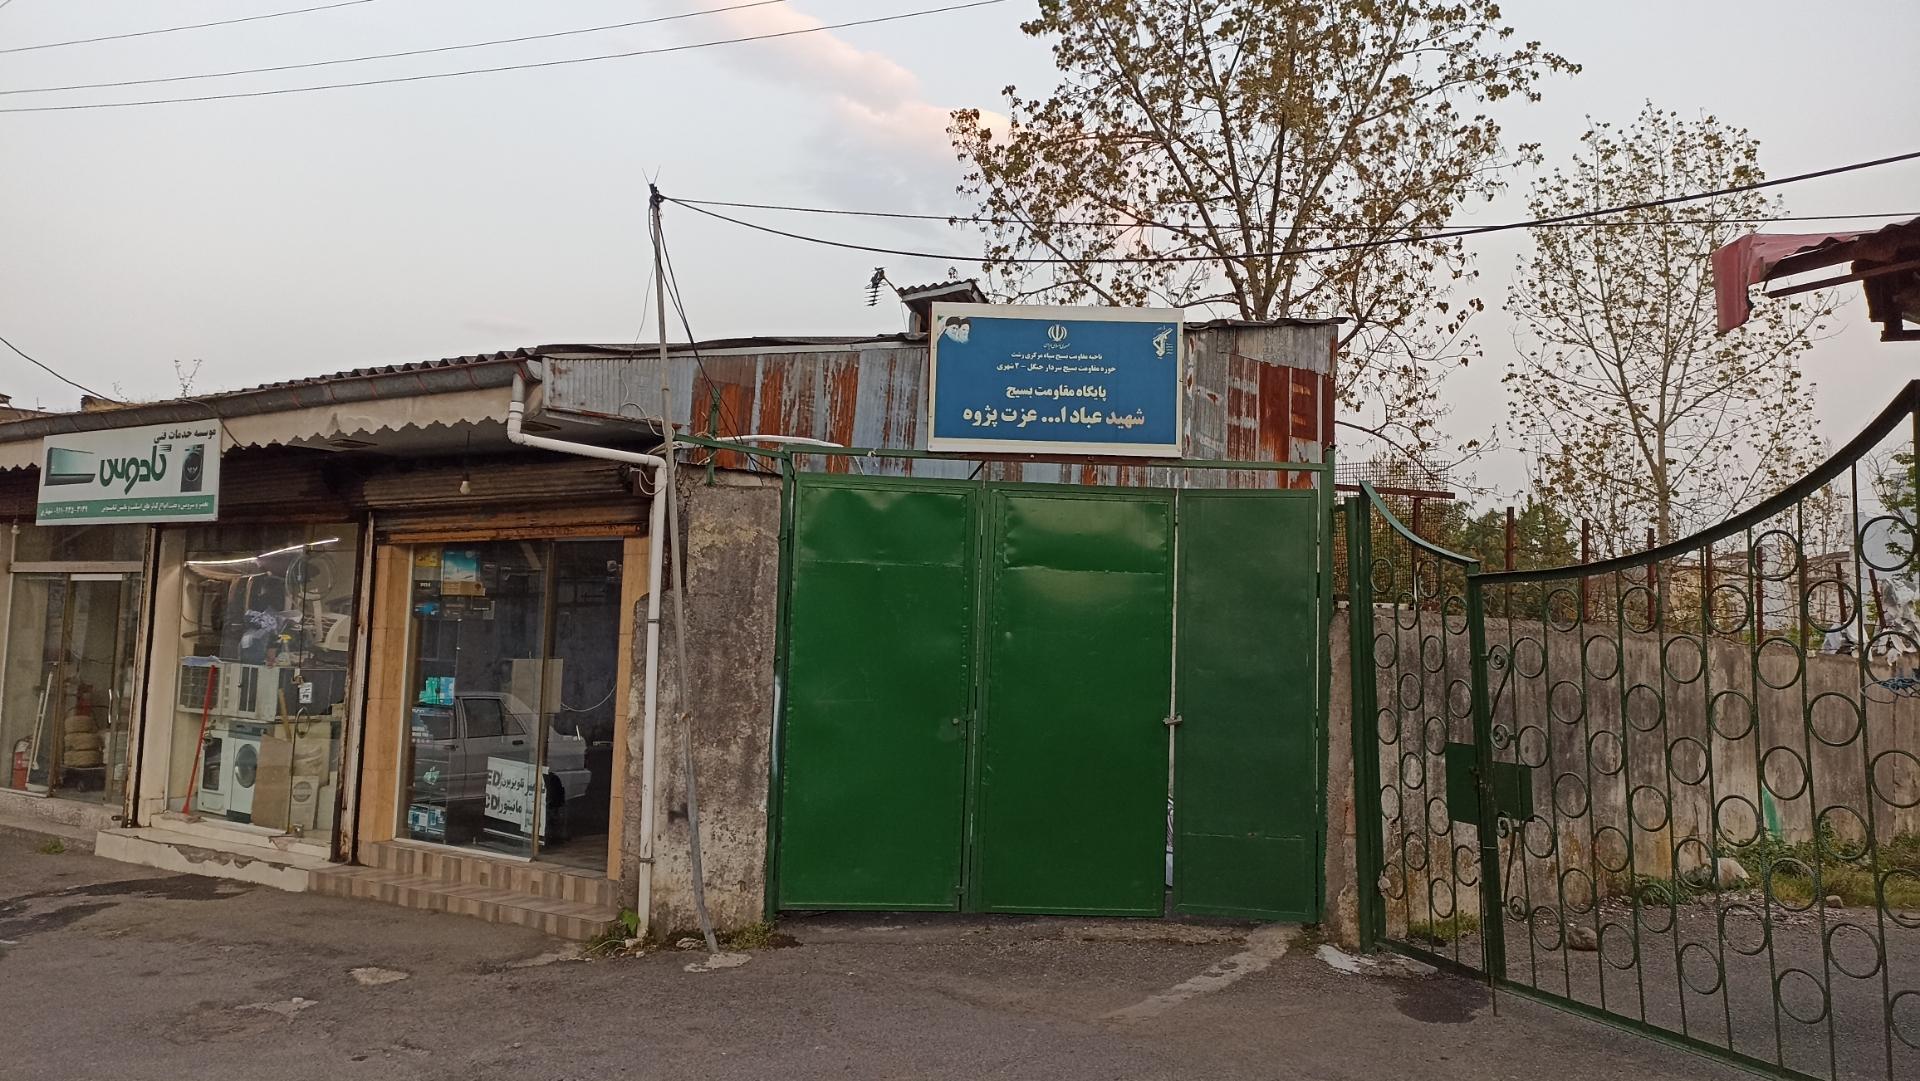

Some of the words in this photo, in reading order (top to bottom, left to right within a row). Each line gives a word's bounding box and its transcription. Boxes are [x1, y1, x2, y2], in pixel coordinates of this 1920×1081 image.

[1010, 351, 1024, 359] رشت
[1025, 351, 1043, 359] مرکزی
[1069, 353, 1088, 361] مقاومت
[996, 362, 1014, 371] شهری
[1027, 363, 1044, 372] جنگل
[1044, 363, 1062, 372] سردار
[1062, 365, 1077, 373] بسیج
[1078, 365, 1100, 373] مقاومت
[1100, 366, 1117, 374] حوزه
[1006, 384, 1033, 398] بسیج
[1034, 384, 1075, 400] مقاومت
[1076, 385, 1107, 402] پایگاه
[963, 404, 998, 427] پژوه
[1000, 407, 1037, 427] عزت
[1069, 406, 1102, 428] عباد
[1105, 408, 1145, 429] شهید
[153, 431, 167, 444] فنی
[168, 429, 192, 440] خدمات
[194, 428, 217, 440] موسسه
[487, 769, 500, 786] ED
[501, 774, 525, 791] تلویزیون
[485, 793, 498, 810] CD
[498, 799, 522, 815] مانیتور
